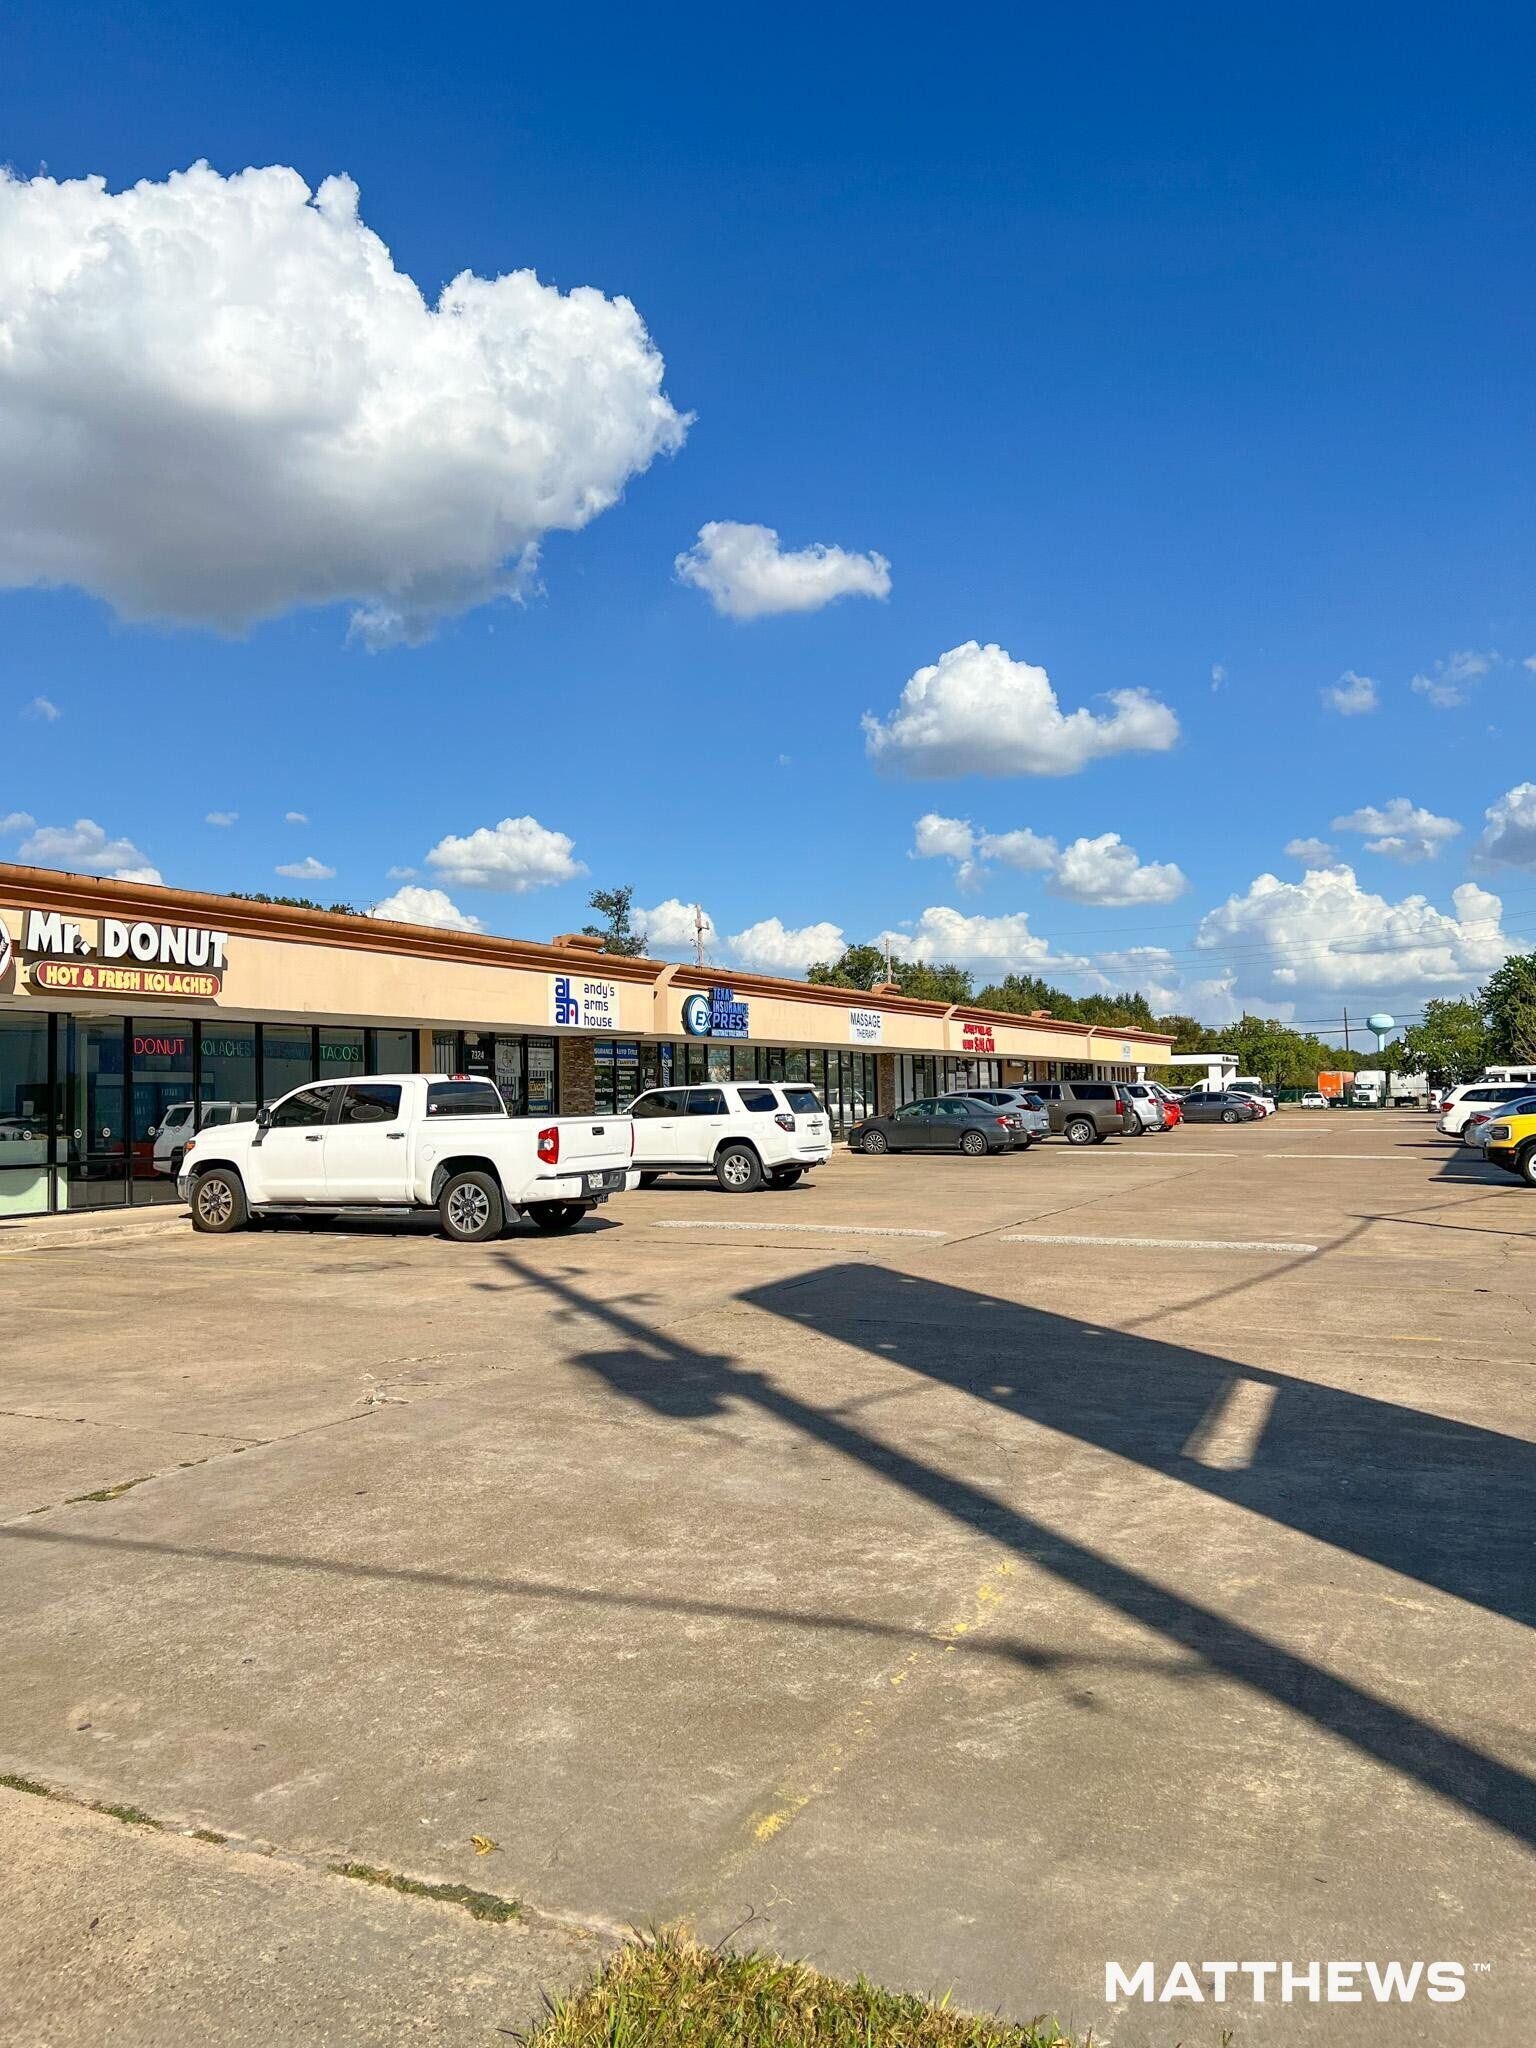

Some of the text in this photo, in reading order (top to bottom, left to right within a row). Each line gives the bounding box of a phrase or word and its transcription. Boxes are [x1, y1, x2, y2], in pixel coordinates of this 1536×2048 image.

[27, 910, 228, 967] Mr. DONUT
[46, 965, 213, 995] HOT & FRESH KOLACHES
[584, 982, 615, 998] andy's
[713, 988, 734, 1001] TEXAS
[584, 999, 609, 1011] arms
[713, 1000, 748, 1015] INSURANCE
[584, 1012, 612, 1027] house
[696, 1011, 748, 1030] EXPRESS
[850, 1012, 881, 1028] MASSAGE
[856, 1028, 877, 1039] THERAPY
[134, 1037, 184, 1055] DONUT
[320, 1045, 359, 1061] TACOS
[471, 1050, 485, 1060] 7324
